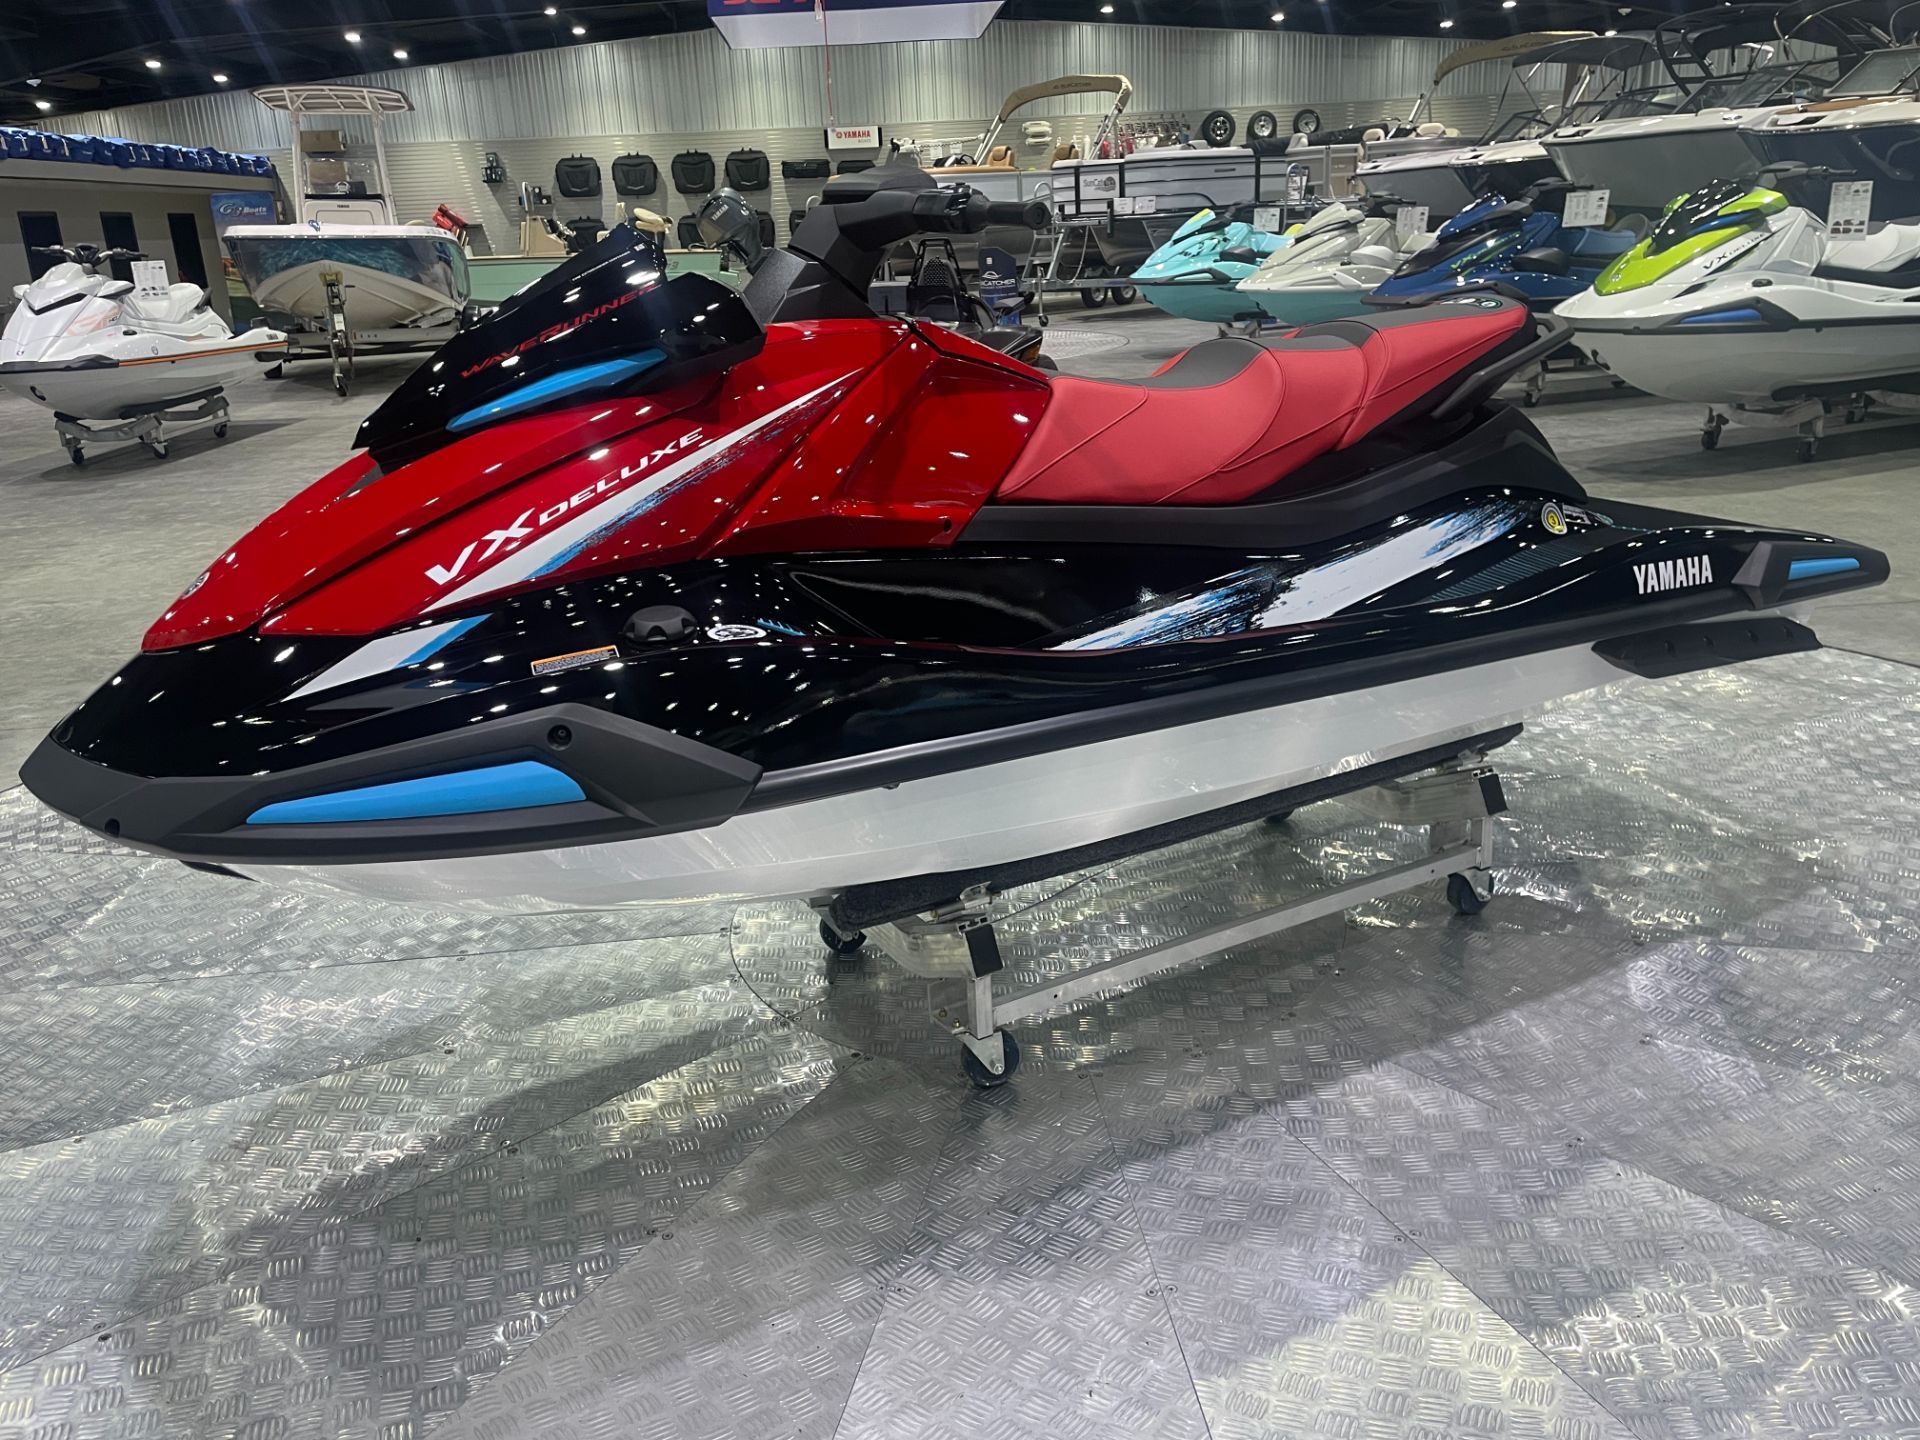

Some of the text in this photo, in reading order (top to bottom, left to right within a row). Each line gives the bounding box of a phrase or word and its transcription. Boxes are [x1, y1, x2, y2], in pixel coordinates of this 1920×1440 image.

[843, 130, 871, 139] YAMAHA
[1703, 252, 1729, 270] VX
[461, 283, 659, 379] WAVERUNNER
[424, 427, 703, 585] VX DELUXE
[1632, 554, 1713, 595] YAMAHA
